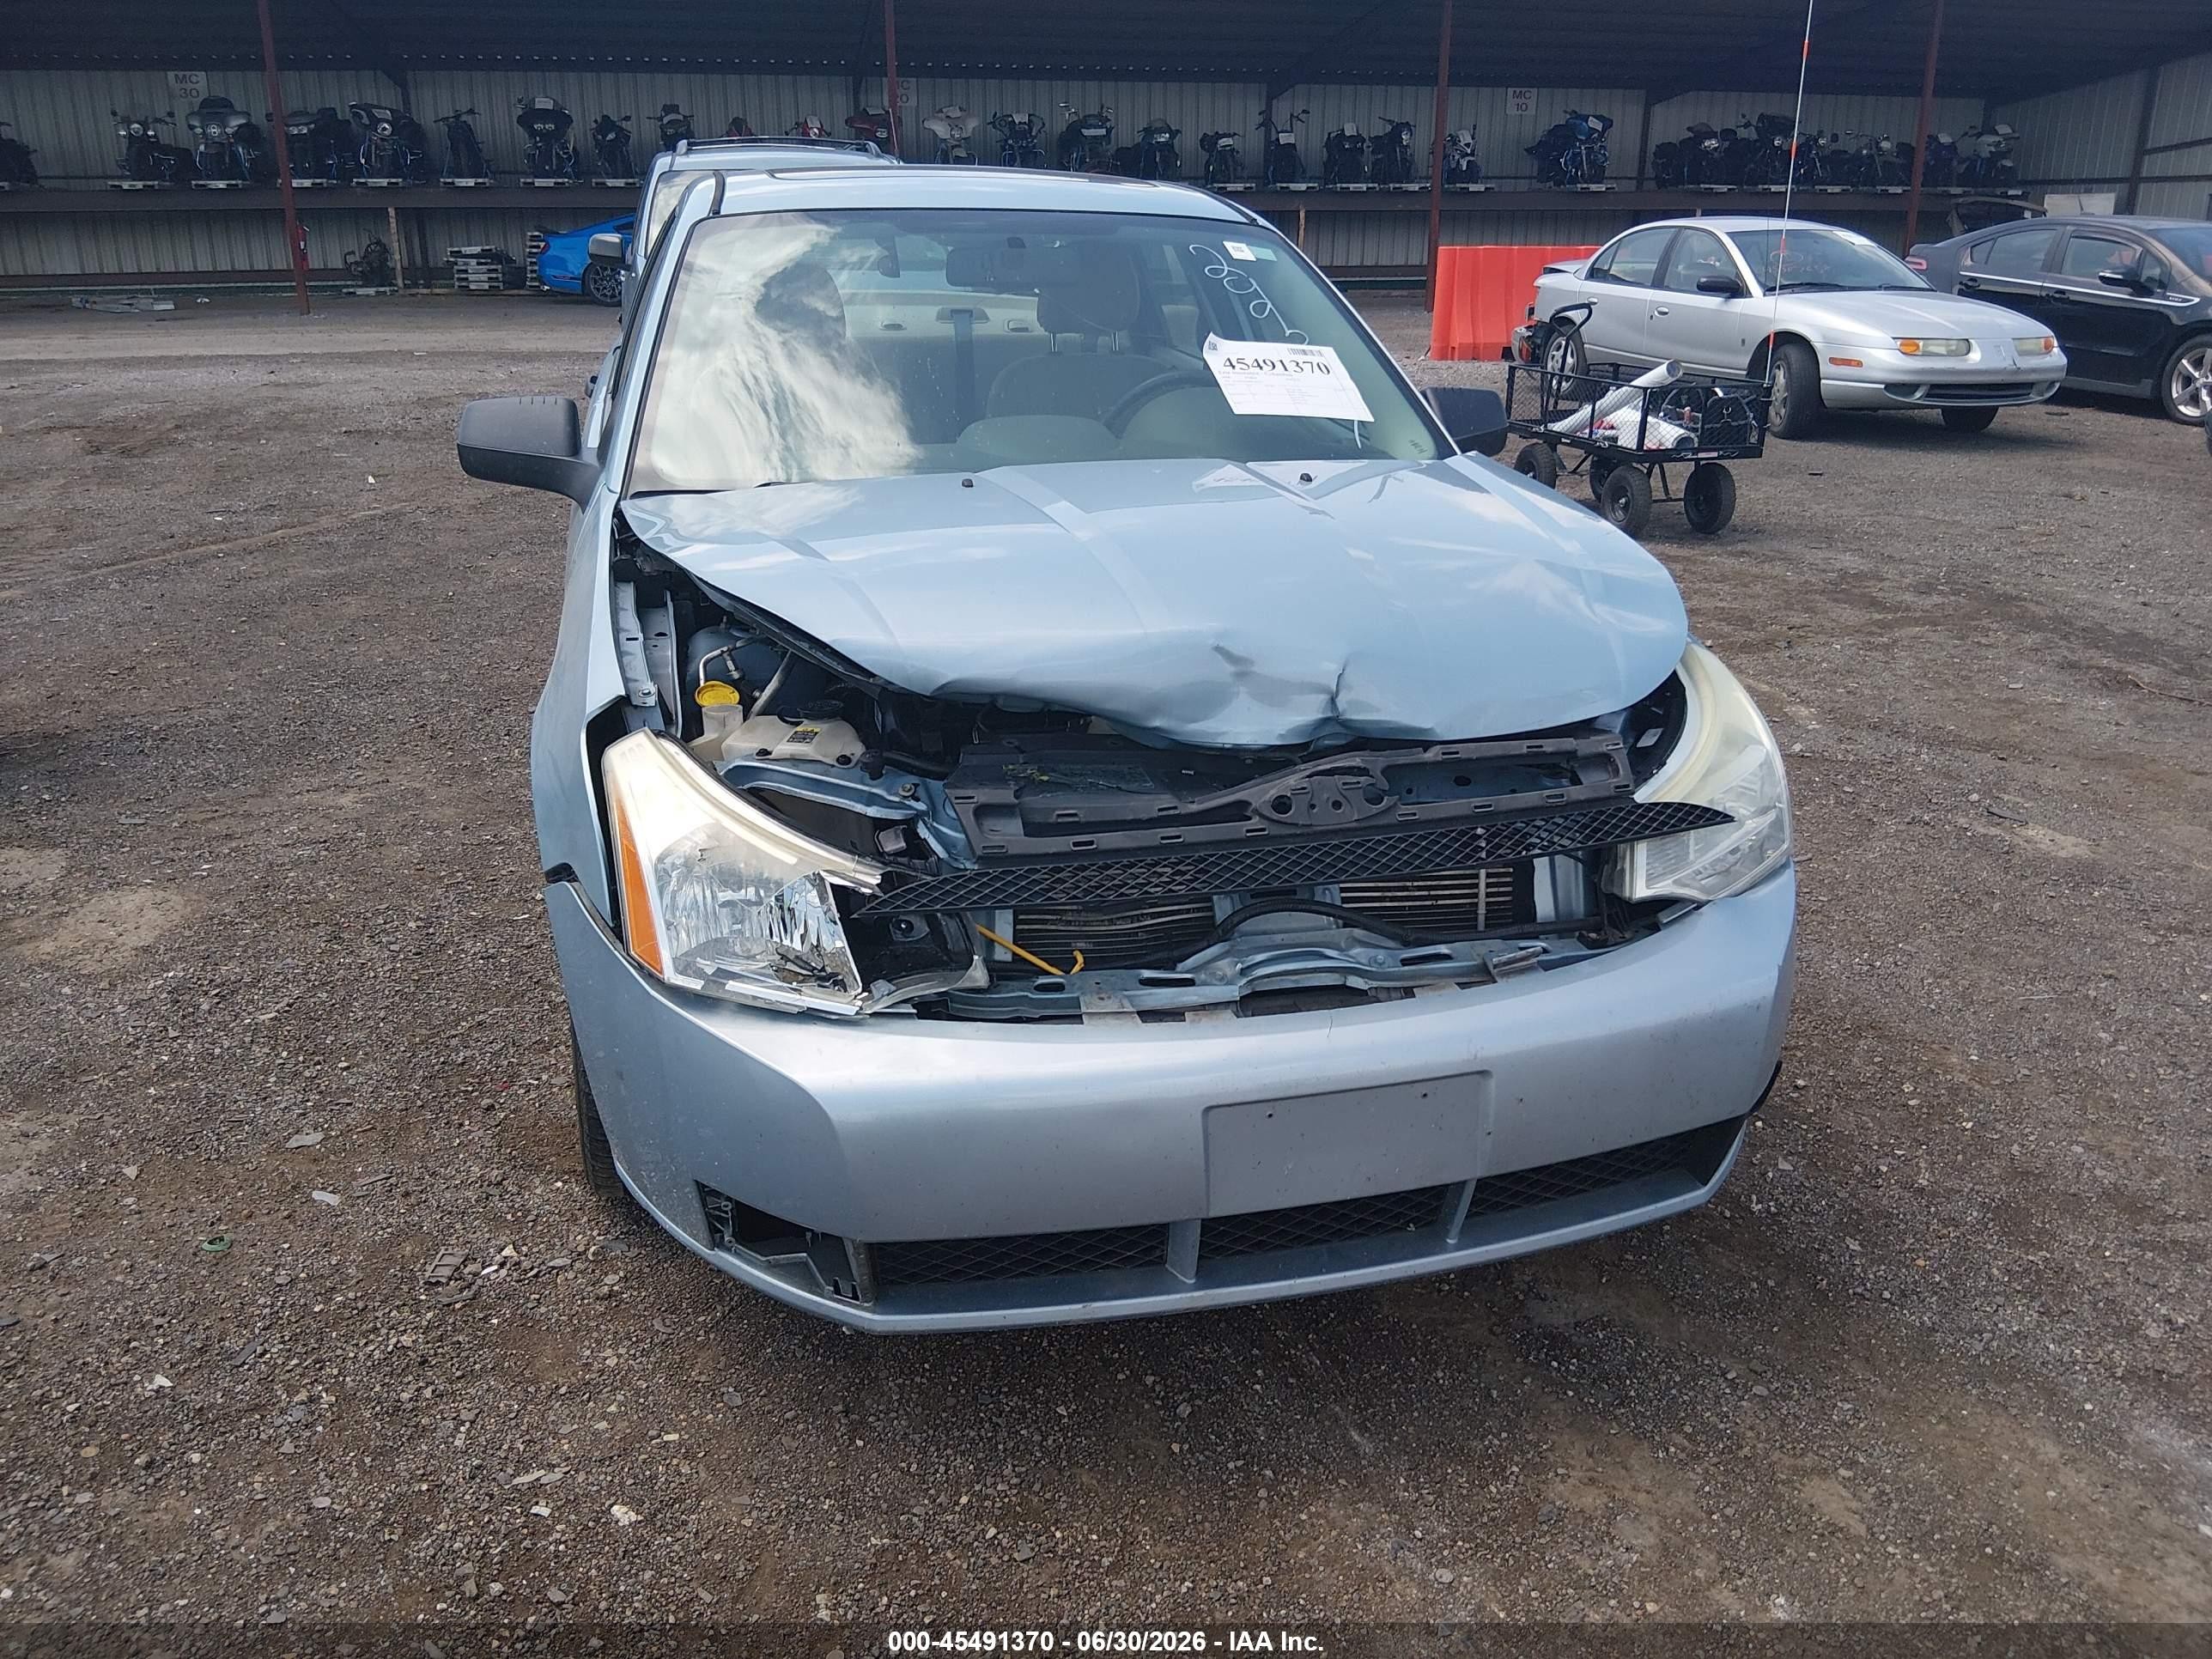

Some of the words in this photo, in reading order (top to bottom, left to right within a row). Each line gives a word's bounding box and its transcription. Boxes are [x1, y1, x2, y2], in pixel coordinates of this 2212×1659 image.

[174, 74, 200, 84] MC
[179, 88, 200, 99] 30
[1512, 90, 1532, 100] MC
[1515, 102, 1528, 112] 10
[1224, 357, 1331, 376] 45491370
